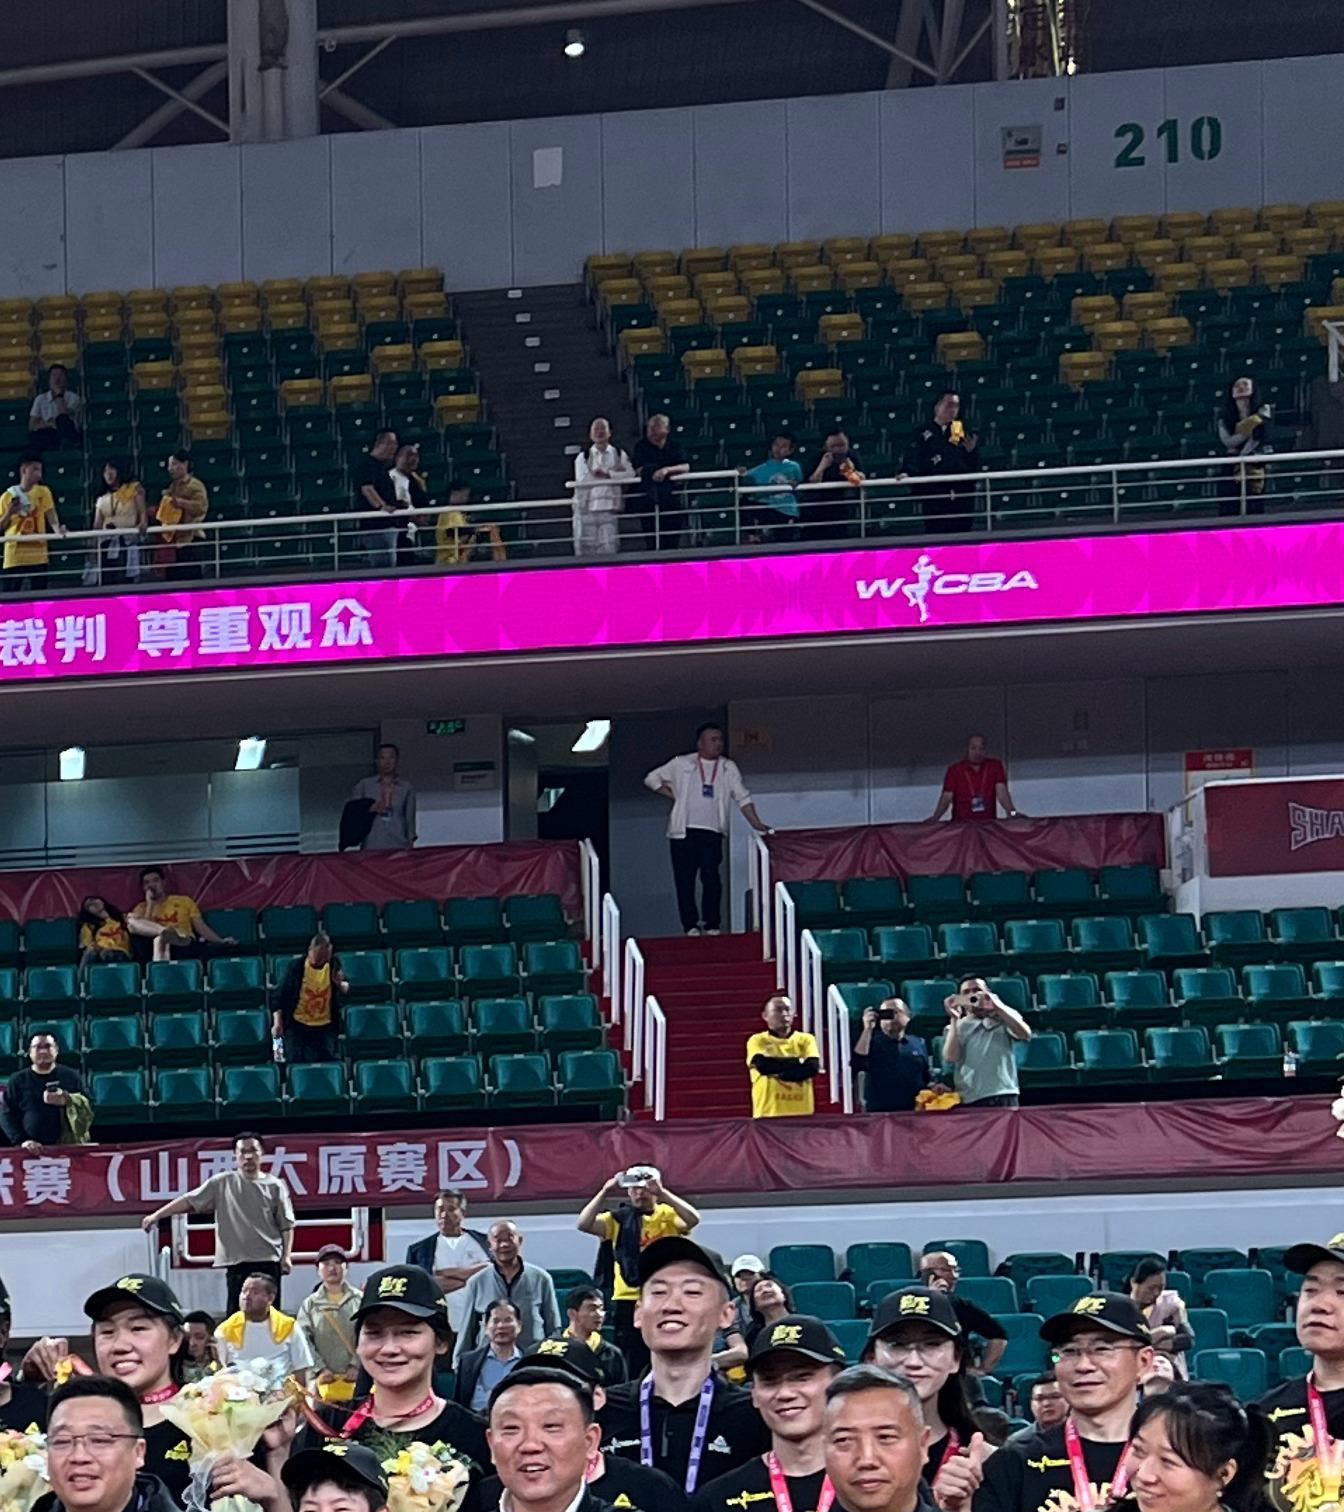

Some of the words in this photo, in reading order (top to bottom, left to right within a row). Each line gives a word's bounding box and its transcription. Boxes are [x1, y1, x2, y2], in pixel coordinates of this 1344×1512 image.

[1114, 116, 1221, 168] 210
[136, 598, 373, 656] 尊重观众
